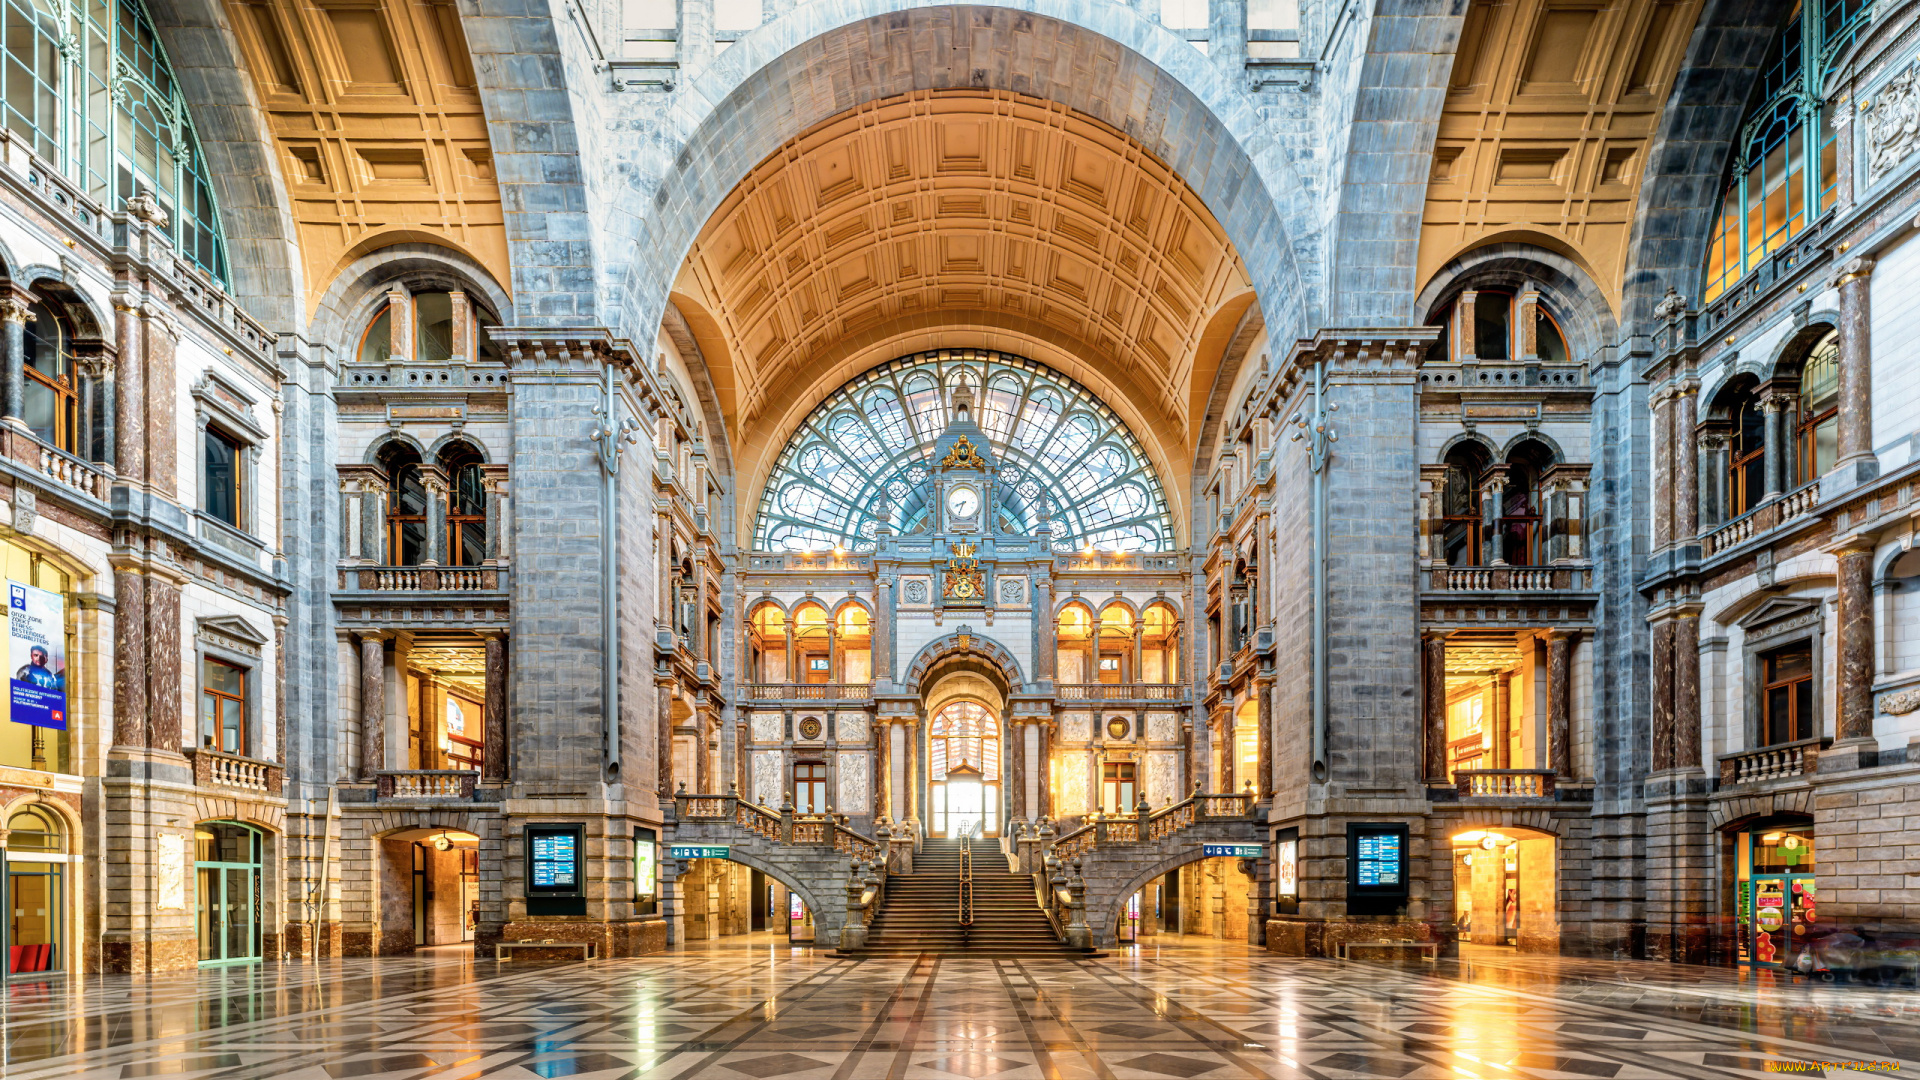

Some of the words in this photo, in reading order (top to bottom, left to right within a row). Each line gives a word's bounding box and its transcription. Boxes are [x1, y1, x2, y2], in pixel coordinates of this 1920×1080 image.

[11, 611, 26, 619] ONZE
[28, 615, 42, 624] ZONE
[11, 616, 30, 625] ZOEKT
